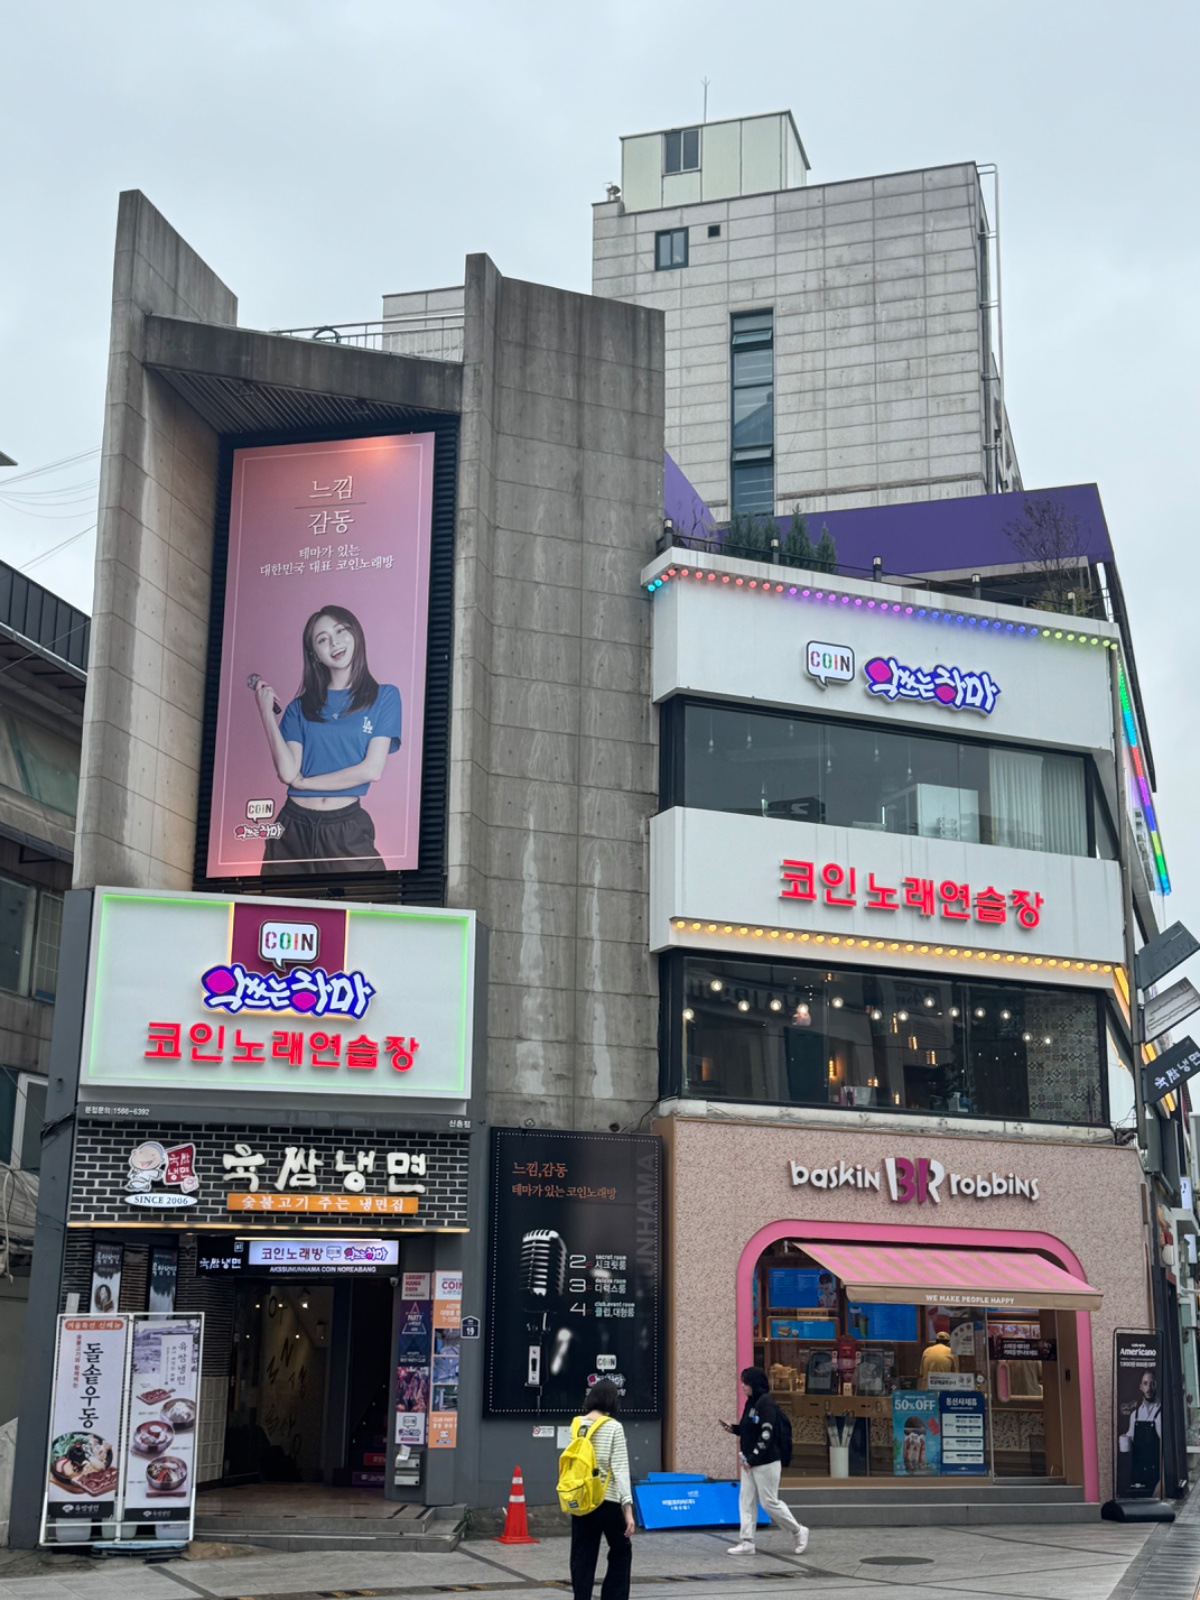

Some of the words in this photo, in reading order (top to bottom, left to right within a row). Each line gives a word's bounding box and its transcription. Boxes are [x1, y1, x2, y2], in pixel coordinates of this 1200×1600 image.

[309, 476, 353, 500] 느낌
[308, 510, 354, 535] 감동
[299, 546, 333, 559] 테마가
[337, 544, 361, 557] 있는
[260, 561, 305, 577] 대한민국
[309, 560, 332, 573] 대표
[336, 555, 395, 571] 코인노래방
[810, 650, 850, 673] COIN
[864, 656, 1001, 715] 악쓰는하마
[248, 803, 272, 814] COIN
[779, 858, 1044, 929] 코인노래연습장
[264, 930, 314, 952] COIN
[201, 962, 376, 1020] 악쓰는하마
[144, 1021, 419, 1073] 코인노래연습장
[222, 1143, 427, 1194] 육쌈냉면
[512, 1161, 568, 1178] 느낌,감동
[788, 1160, 880, 1191] baskin
[883, 1157, 945, 1204] BR
[948, 1172, 1040, 1201] robbins
[134, 1195, 164, 1204] SINCE
[166, 1196, 189, 1205] 2006
[511, 1183, 542, 1197] 테마가
[544, 1184, 565, 1198] 있는
[566, 1185, 616, 1200] 코인노래방
[242, 1195, 309, 1210] 숯불고기
[318, 1196, 350, 1211] 주는
[359, 1198, 404, 1212] 냉면집
[261, 1247, 324, 1261] 코인노래방
[569, 1254, 587, 1269] 2
[594, 1260, 627, 1270] 시크릿룸
[569, 1278, 587, 1293] 3
[594, 1284, 627, 1294] 디럭스룸
[925, 1294, 938, 1302] WE
[939, 1295, 960, 1303] MAKE
[962, 1296, 989, 1304] PEOPLE
[569, 1303, 586, 1316] 4
[1119, 1348, 1157, 1356] Americano
[78, 1342, 104, 1429] 돌솥우동
